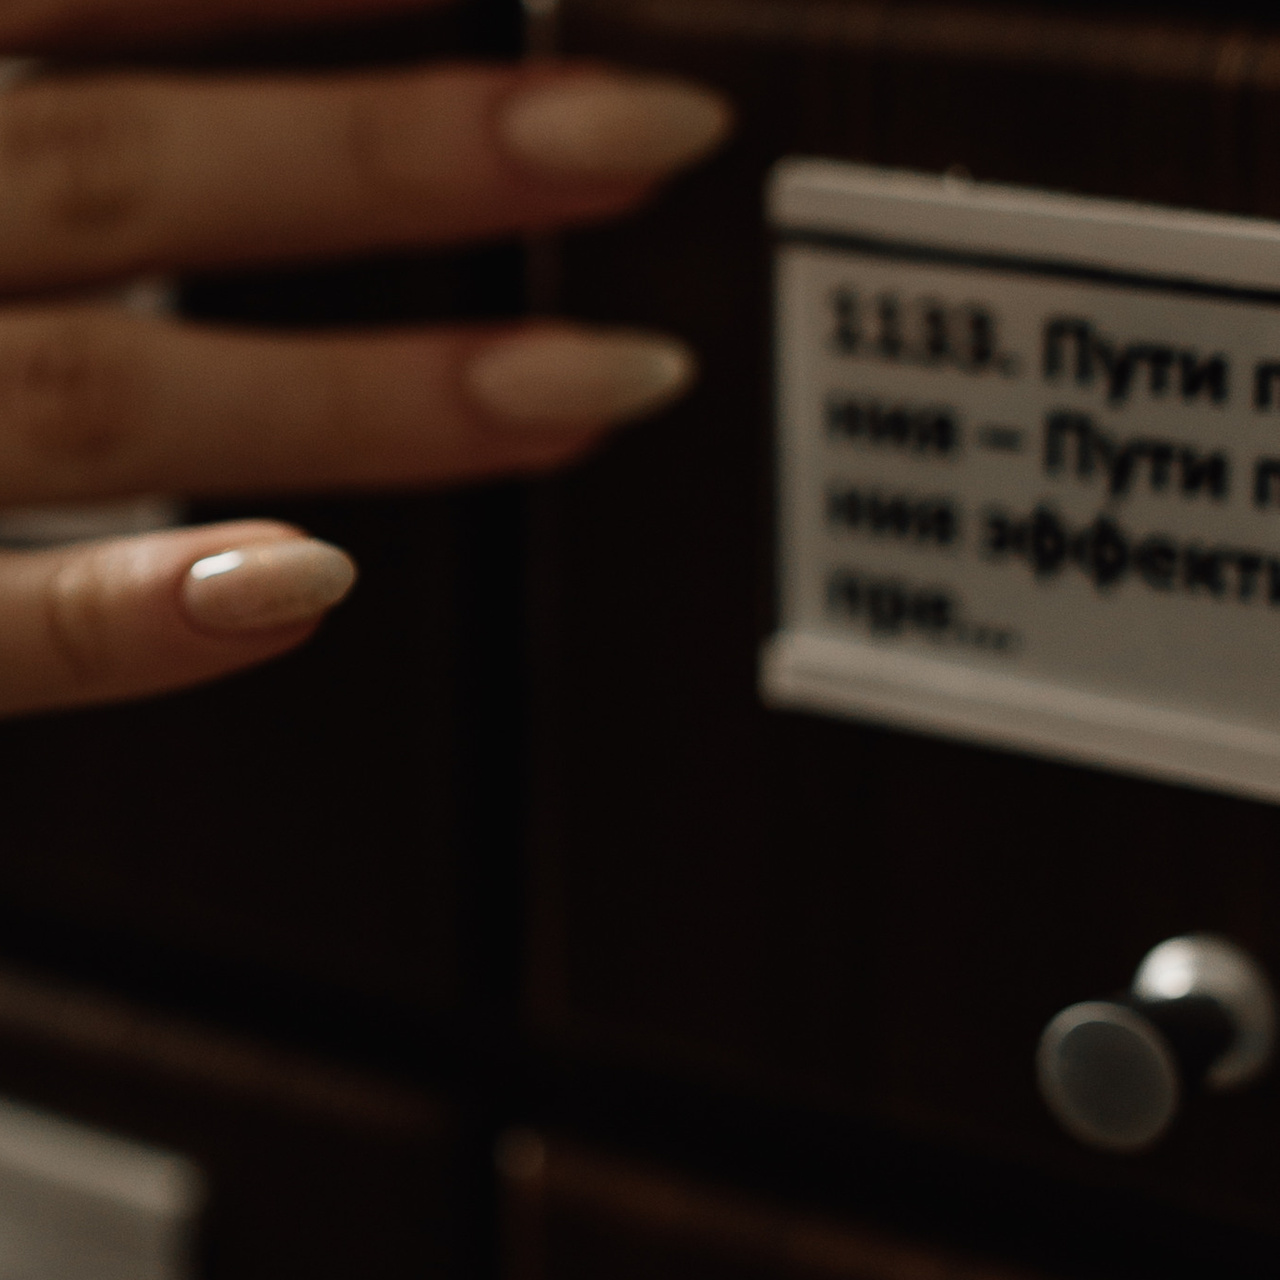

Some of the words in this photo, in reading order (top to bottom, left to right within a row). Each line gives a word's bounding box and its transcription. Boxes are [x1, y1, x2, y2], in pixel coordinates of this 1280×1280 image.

[1043, 316, 1229, 411] Пути
[1043, 410, 1229, 504] Пути
[982, 498, 1280, 608] эффект
